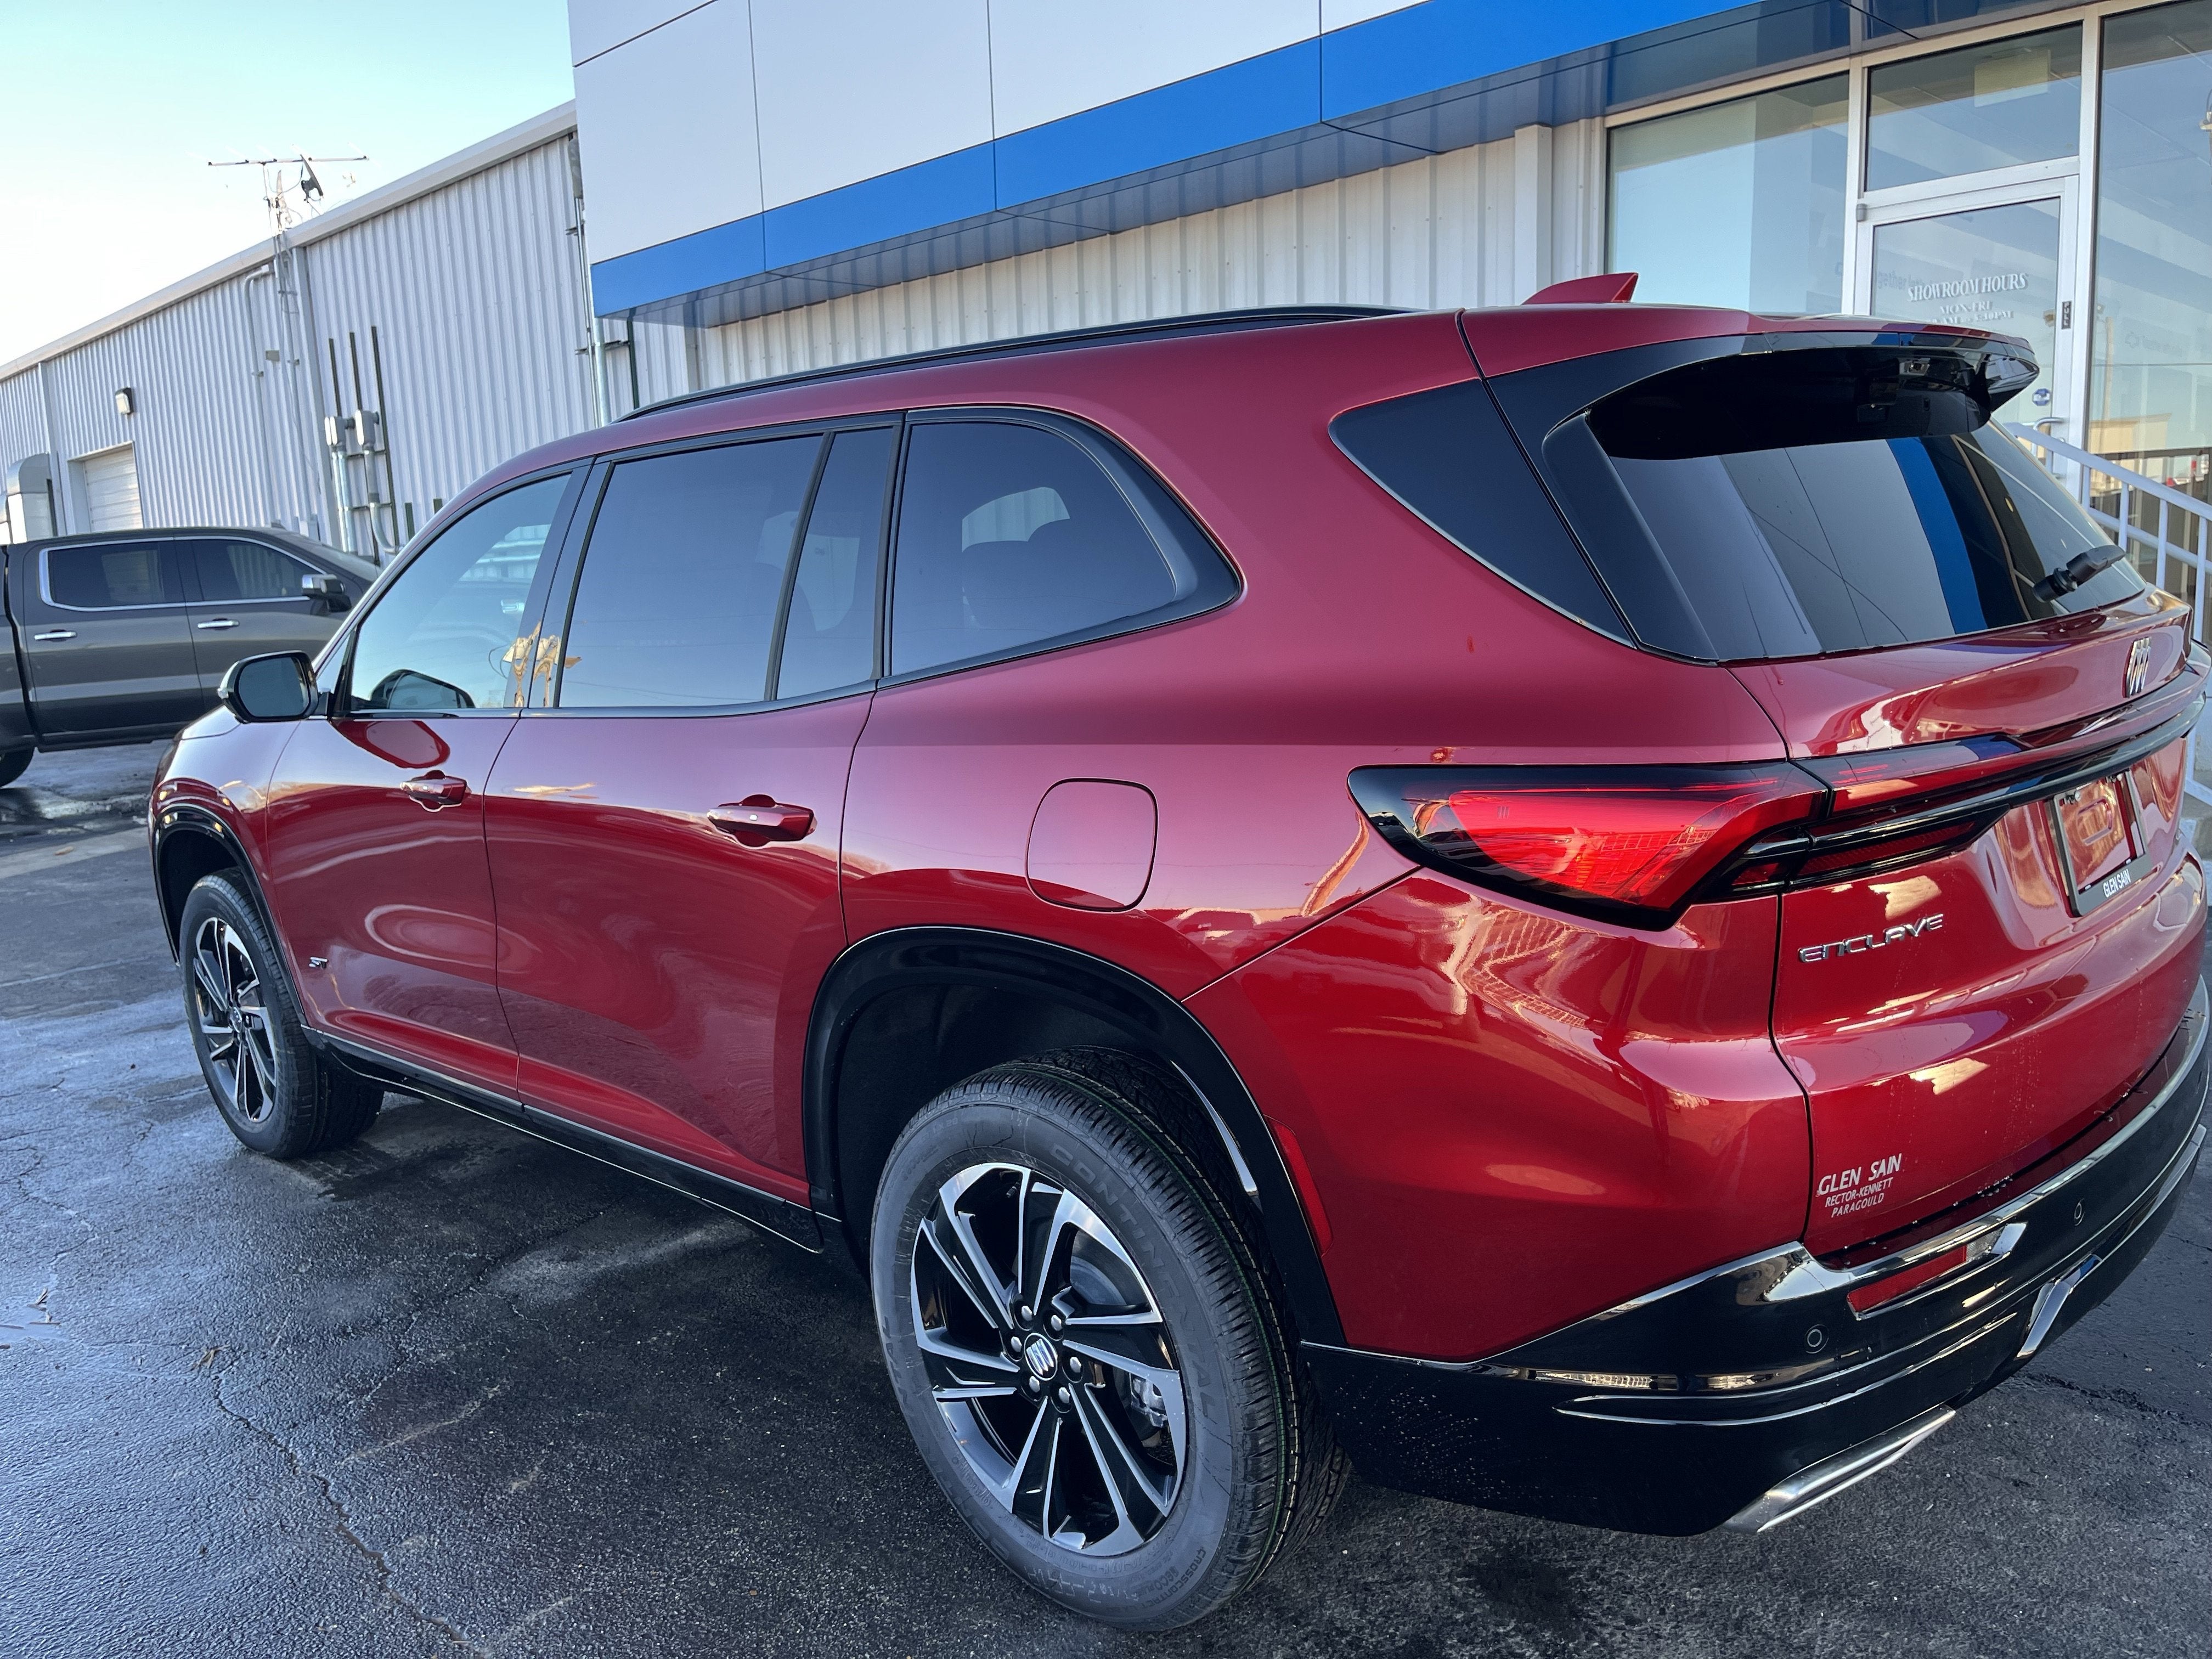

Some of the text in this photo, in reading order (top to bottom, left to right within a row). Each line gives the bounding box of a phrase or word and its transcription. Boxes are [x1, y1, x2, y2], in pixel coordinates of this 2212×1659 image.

[1907, 273, 2028, 302] SHOWROOM HOURS
[2103, 868, 2131, 898] GLEN SAIN
[1798, 913, 1944, 963] ENCLAVE
[1818, 1153, 1903, 1195] GLEN SAIN
[1825, 1177, 1894, 1207] RECTOR-KENNETT
[1831, 1192, 1884, 1218] PARAGOULD
